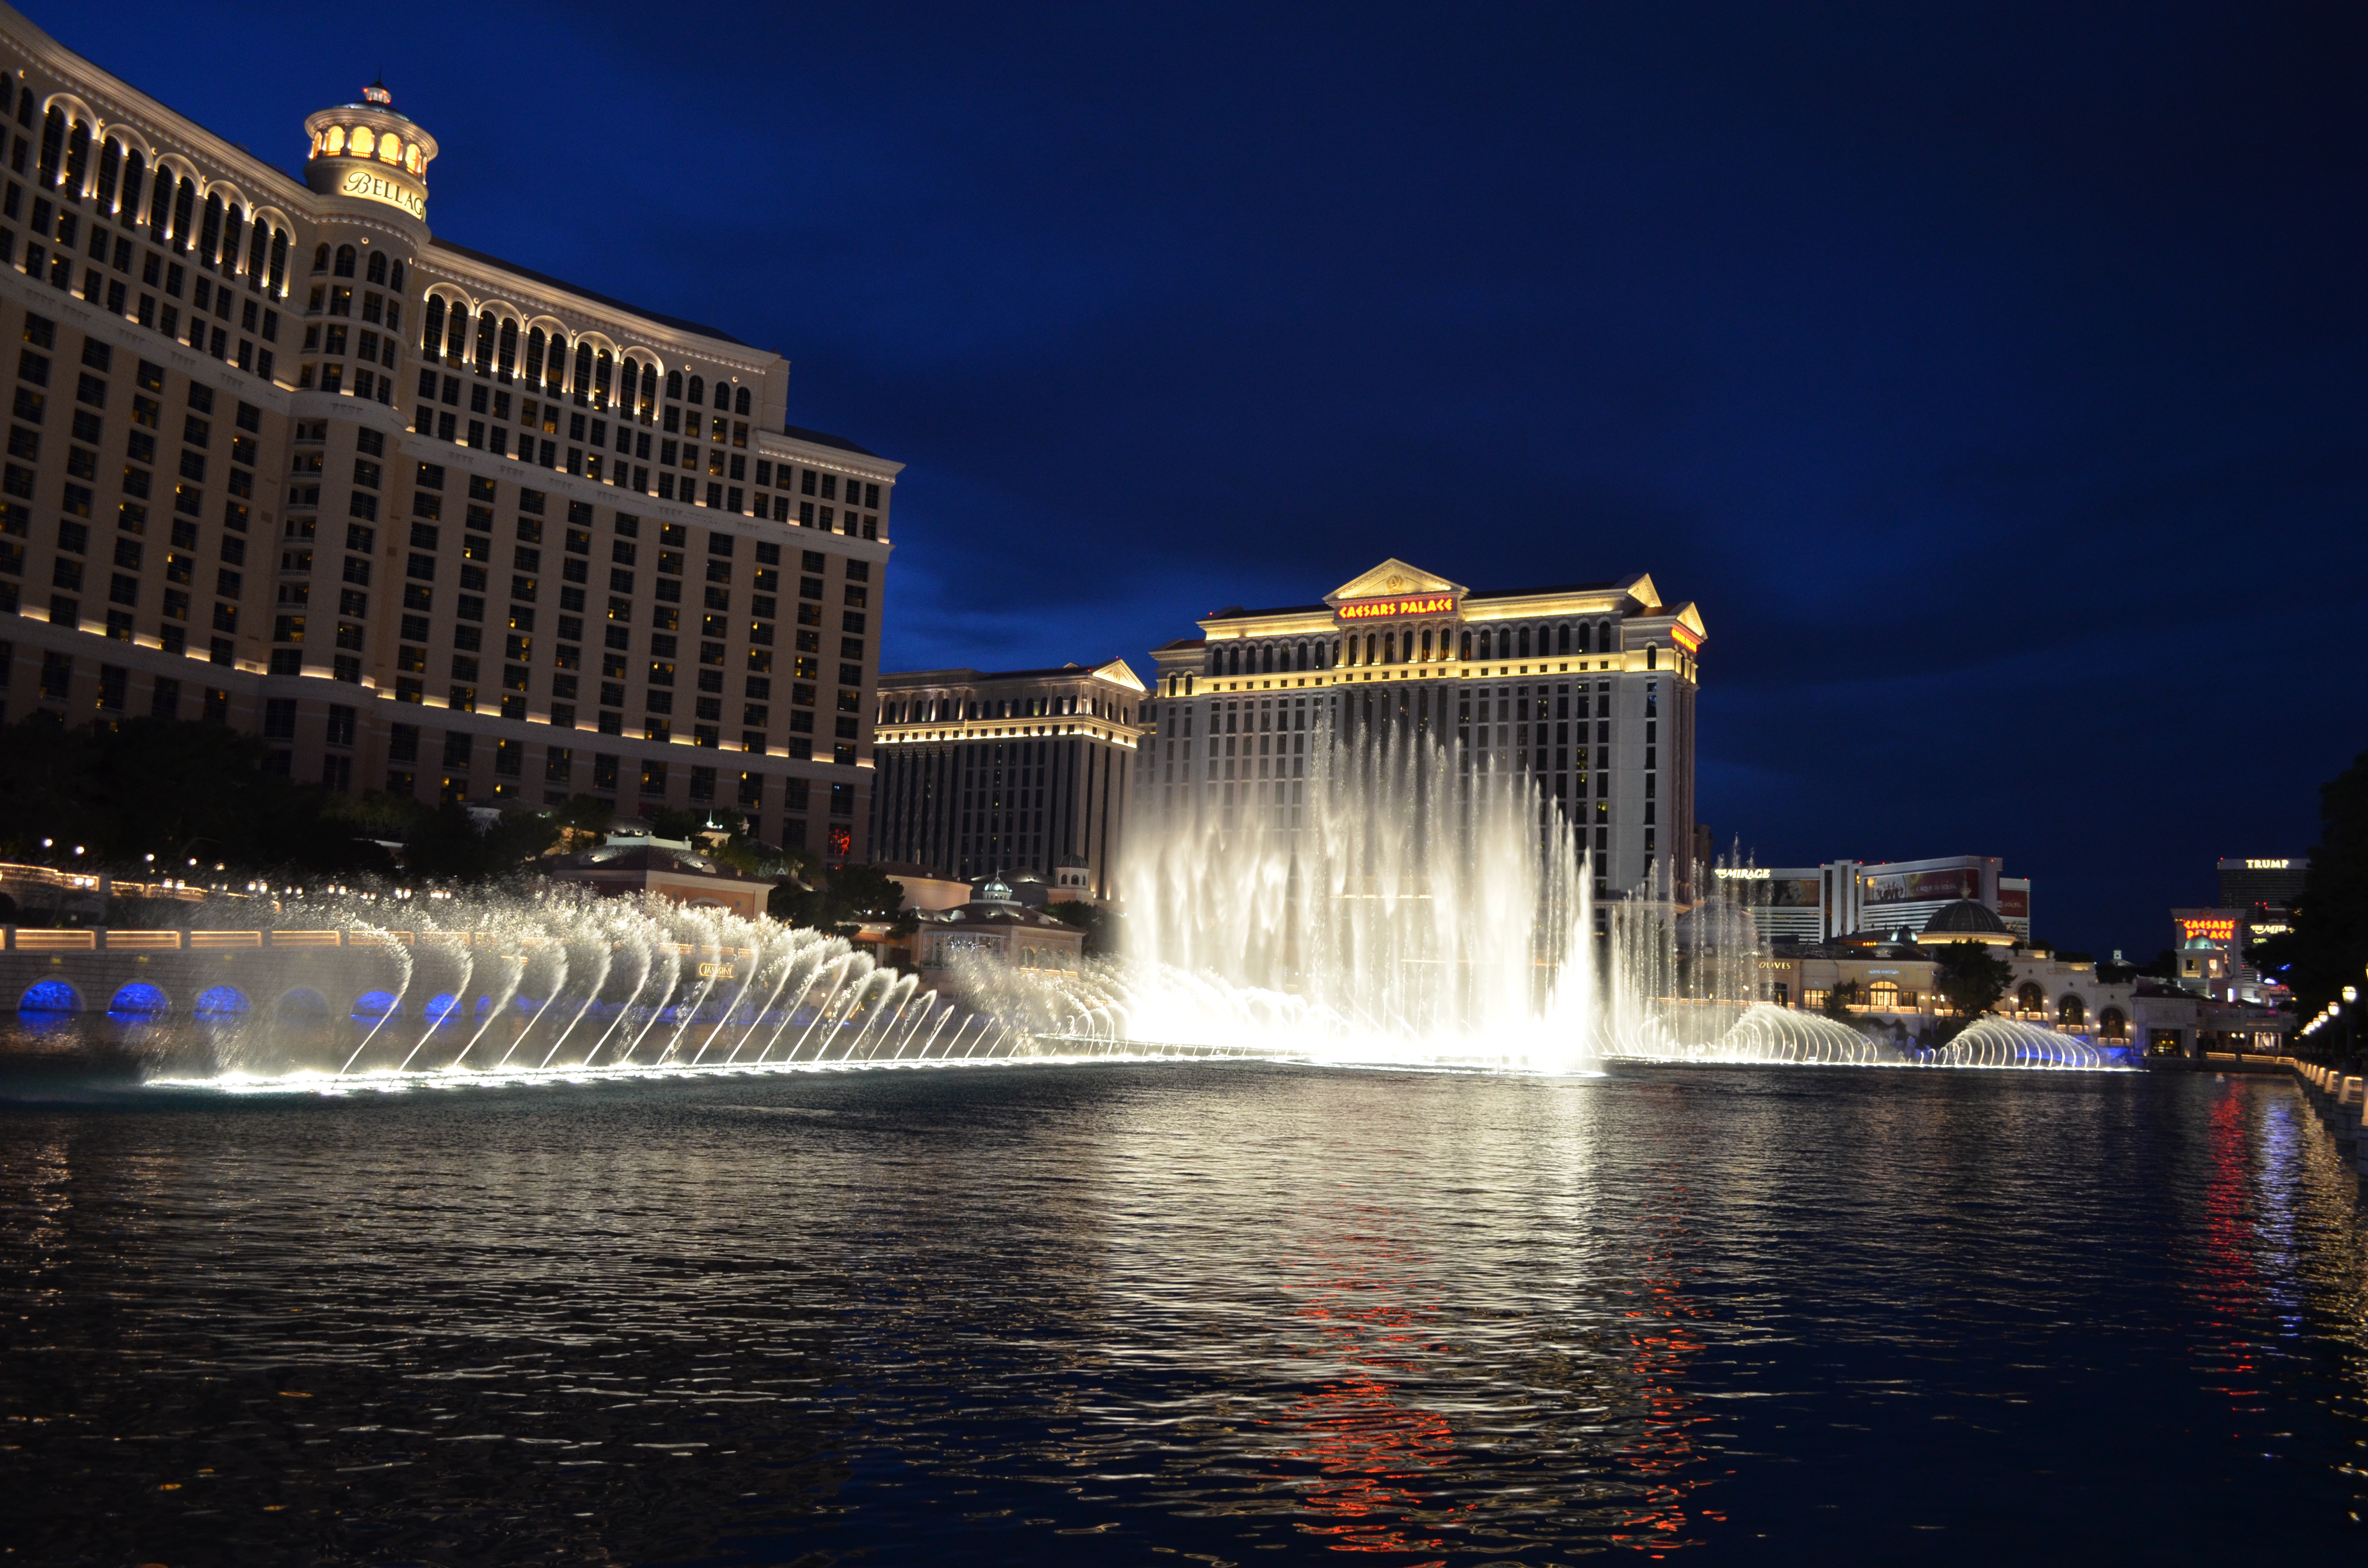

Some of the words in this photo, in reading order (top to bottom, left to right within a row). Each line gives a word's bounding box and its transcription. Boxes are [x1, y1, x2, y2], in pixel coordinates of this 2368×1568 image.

[1339, 602, 1396, 619] CAESARS
[1400, 598, 1452, 614] PALACE
[2245, 859, 2288, 869] TRUMP
[1718, 869, 1770, 880] MIRAGE
[2183, 919, 2234, 929] CAESARS
